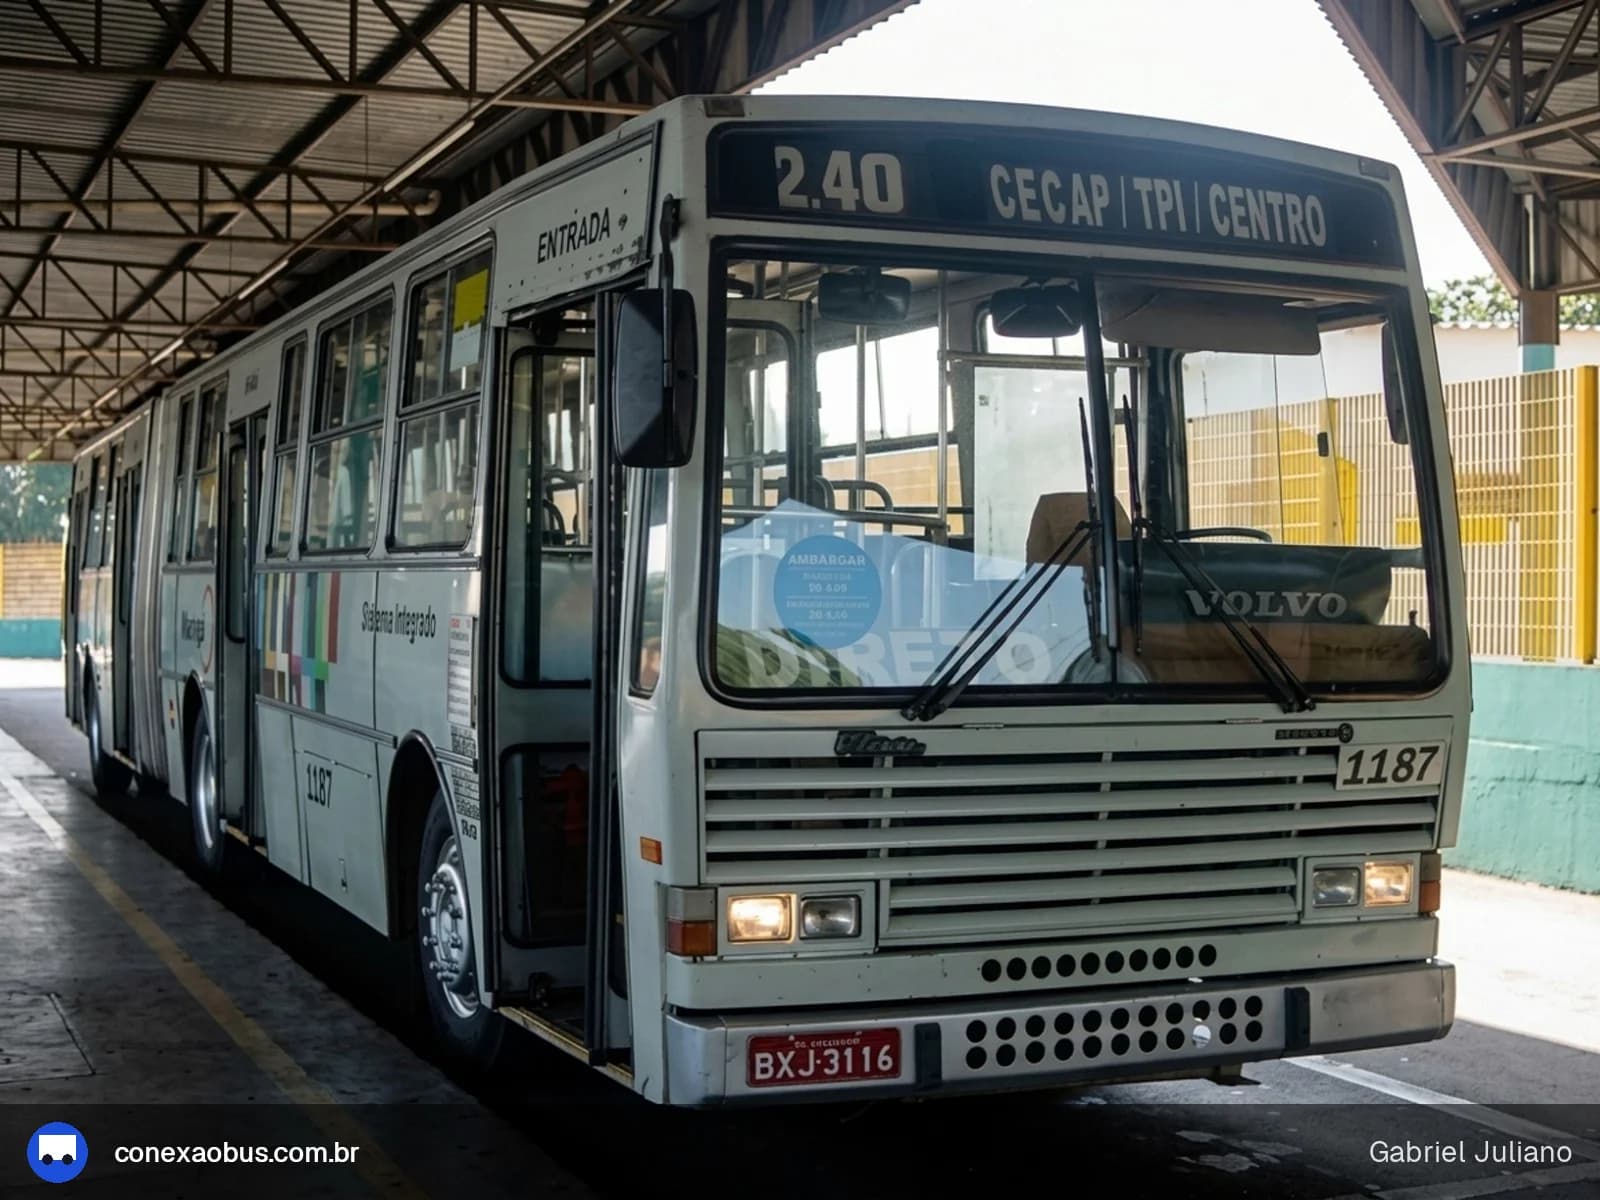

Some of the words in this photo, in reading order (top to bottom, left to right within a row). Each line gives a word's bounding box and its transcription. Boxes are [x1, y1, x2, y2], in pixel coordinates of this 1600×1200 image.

[774, 145, 904, 213] 2.40
[990, 164, 1110, 228] CECAP
[1133, 177, 1187, 232] TPI
[1208, 183, 1326, 247] CENTRO
[537, 207, 610, 264] ENTRADA
[395, 603, 437, 644] Integrado
[1185, 590, 1347, 618] VOLVO
[307, 763, 332, 808] 1187
[1342, 746, 1440, 785] 1187
